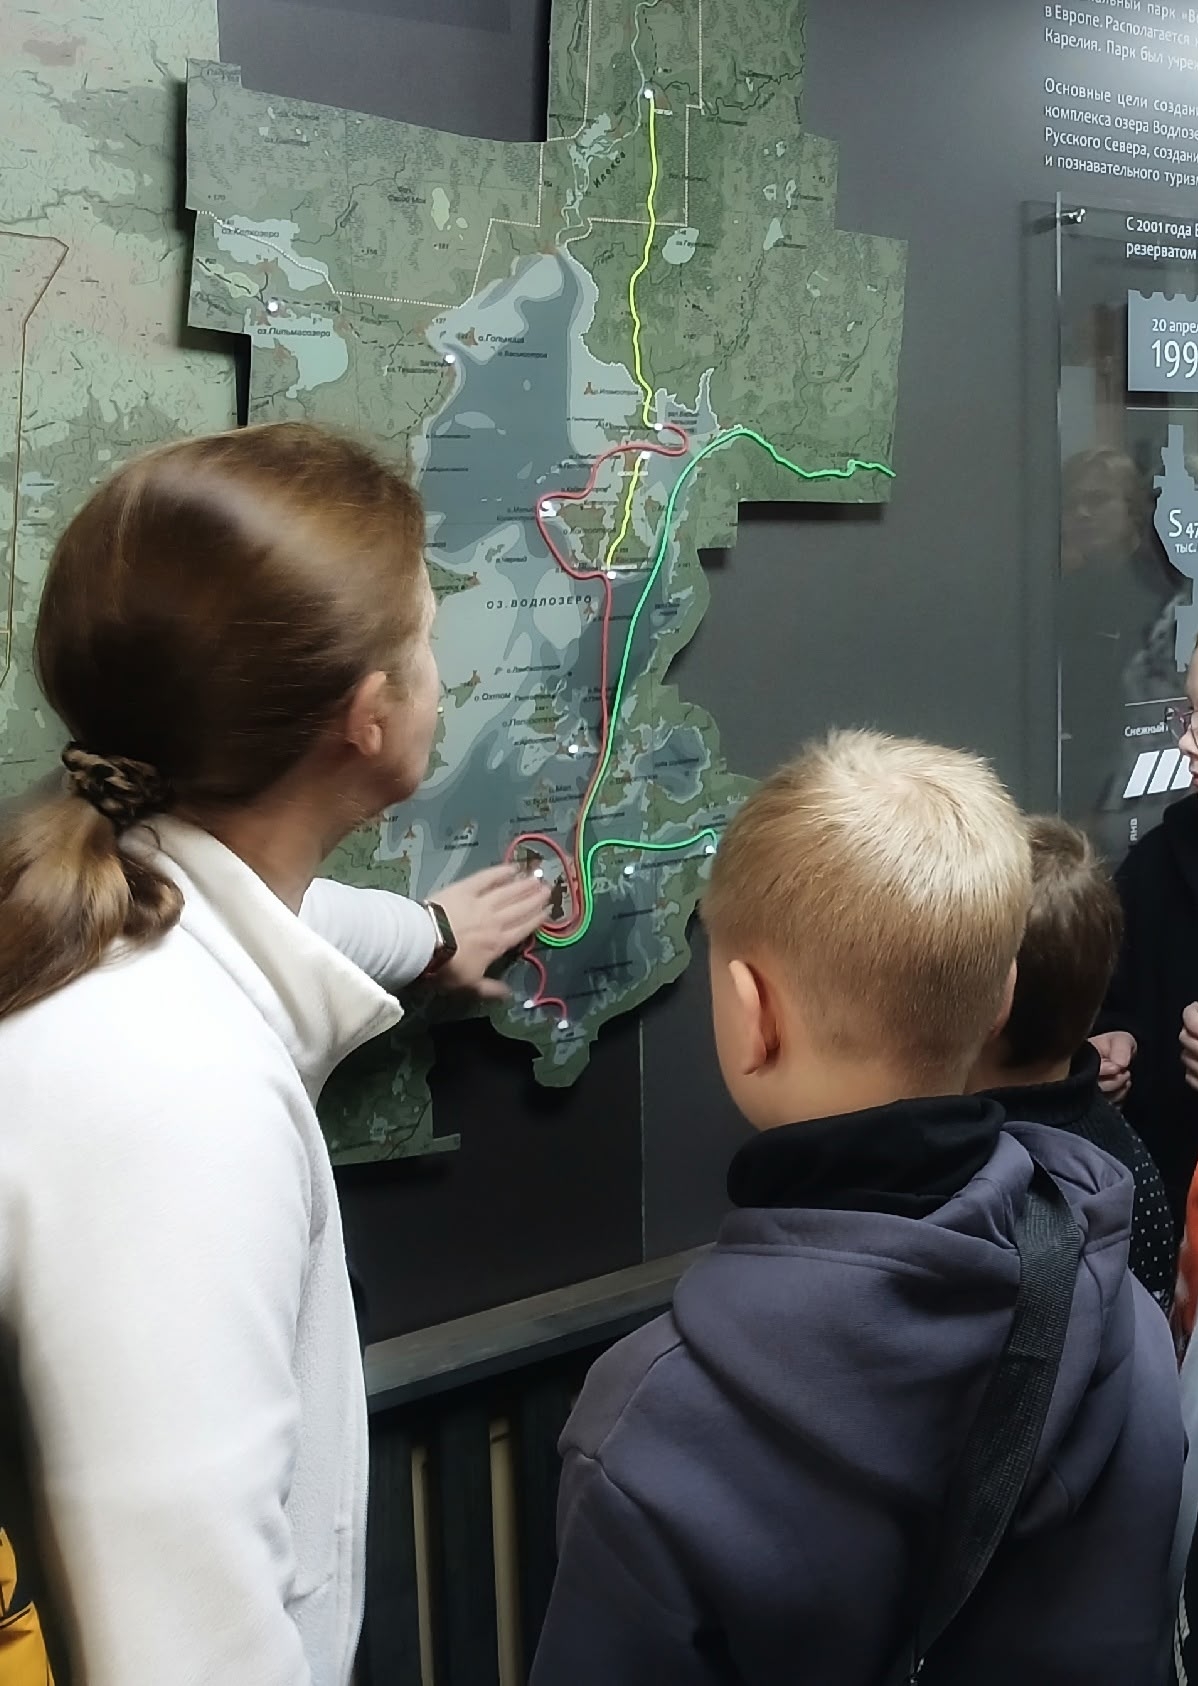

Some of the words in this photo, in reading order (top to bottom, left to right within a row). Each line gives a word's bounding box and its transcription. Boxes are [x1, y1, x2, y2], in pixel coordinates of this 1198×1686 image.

[1045, 6, 1052, 17] в
[1055, 5, 1103, 27] Европе.
[1106, 15, 1190, 45] Располагается
[1148, 3, 1176, 20] парк
[1045, 27, 1101, 51] Карелия.
[1107, 40, 1136, 60] Парк
[1141, 46, 1163, 64] был
[1045, 77, 1111, 102] Основные
[1117, 93, 1148, 108] цели
[1045, 106, 1111, 127] комплекса
[1114, 116, 1149, 134] озера
[1045, 126, 1101, 149] Русского
[1104, 136, 1150, 159] Севера,
[1045, 155, 1053, 167] и
[1057, 156, 1160, 181] познавательного
[1126, 216, 1134, 231] С
[1136, 219, 1163, 234] 2001
[1165, 222, 1192, 239] года
[1126, 242, 1197, 260] резерватом
[1151, 318, 1167, 332] 20
[1168, 509, 1183, 538] S
